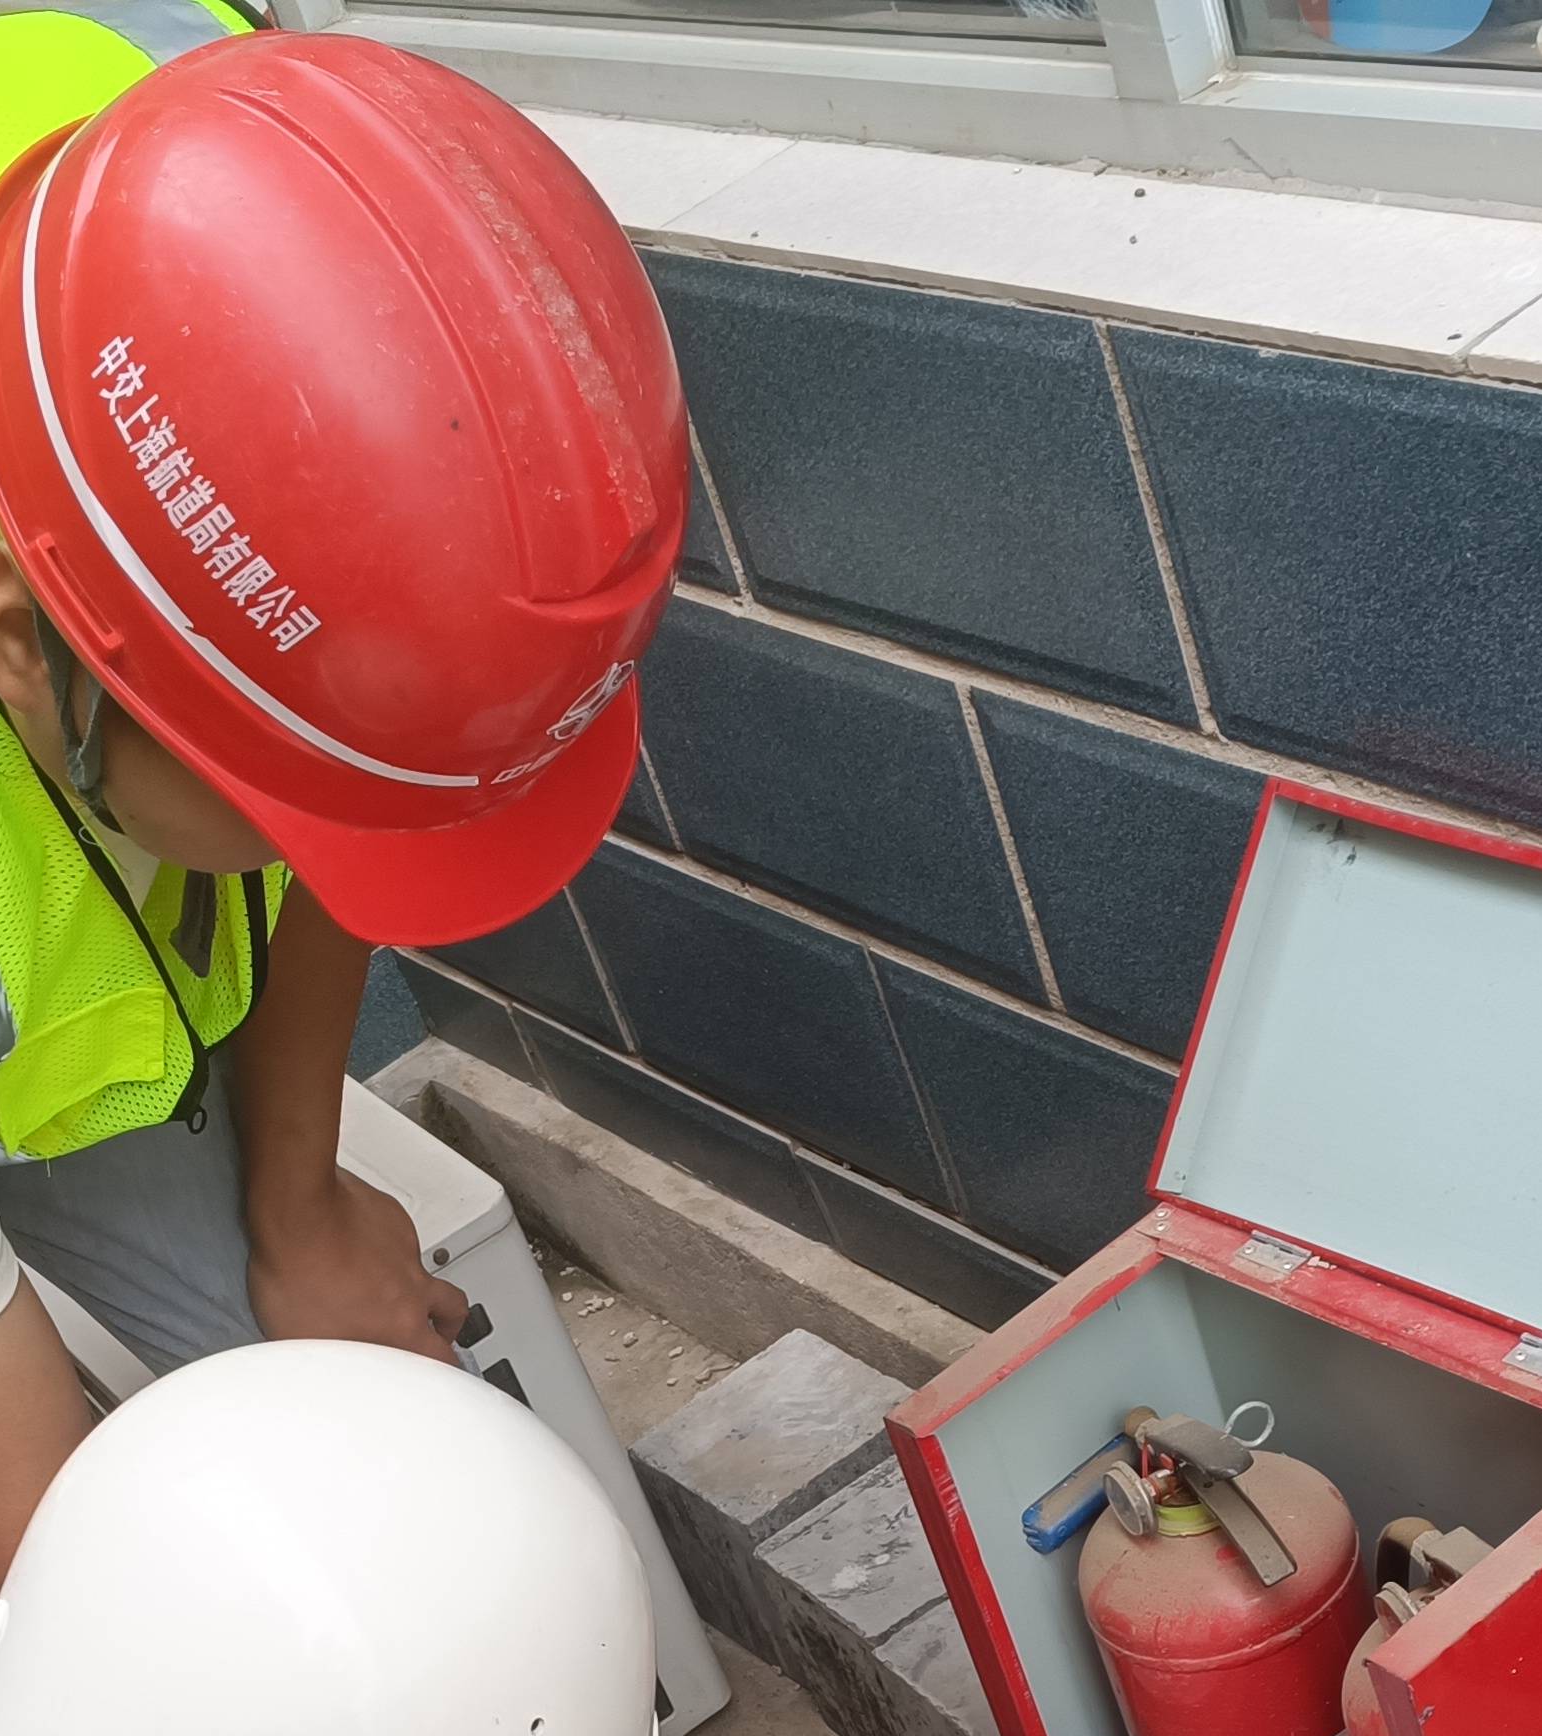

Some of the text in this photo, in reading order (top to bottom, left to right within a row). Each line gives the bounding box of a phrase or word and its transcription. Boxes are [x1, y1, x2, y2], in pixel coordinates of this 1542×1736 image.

[91, 336, 322, 653] 中交上海航道局有限公司
